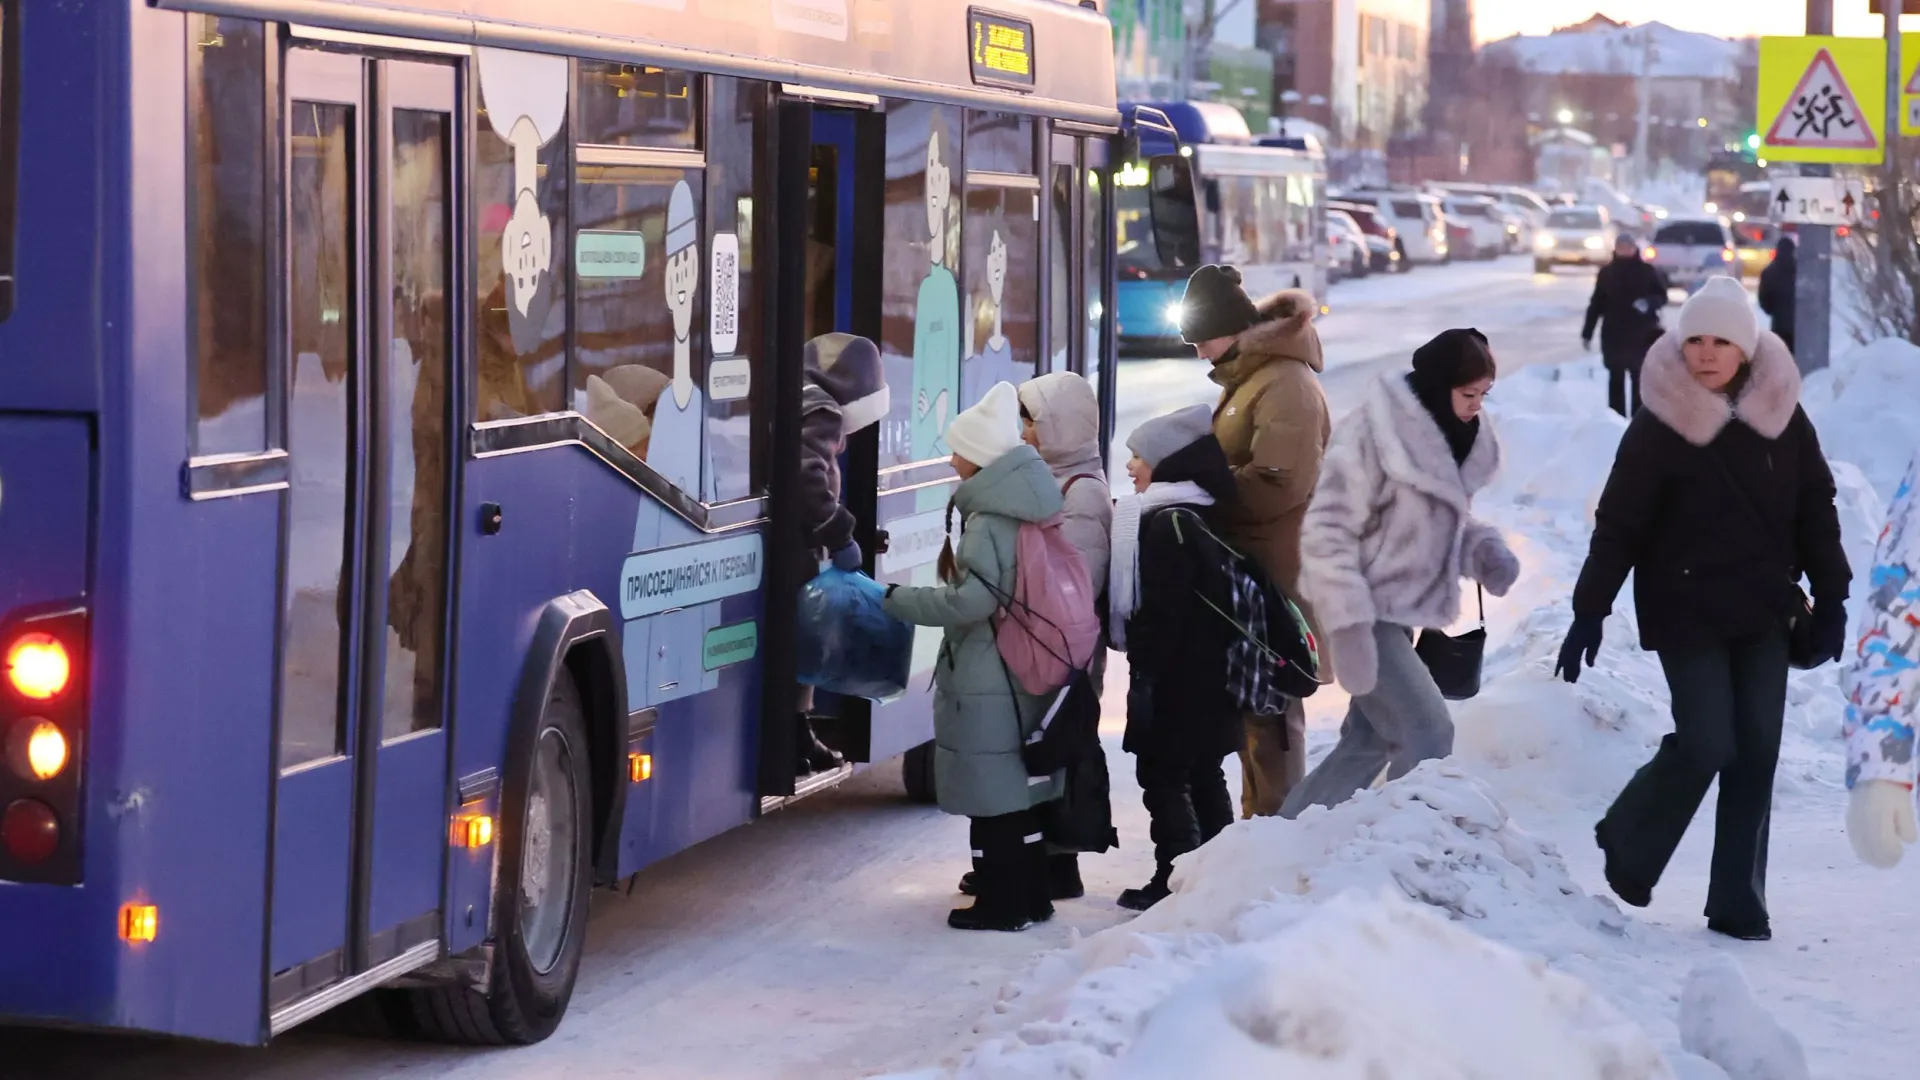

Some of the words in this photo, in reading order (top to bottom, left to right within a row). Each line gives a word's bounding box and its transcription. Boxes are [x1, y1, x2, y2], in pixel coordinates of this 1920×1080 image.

[627, 559, 711, 601] ПРИСОЕДИНЯЙСЯ
[711, 560, 718, 583] К
[719, 552, 757, 580] ПЕРВЫМ
